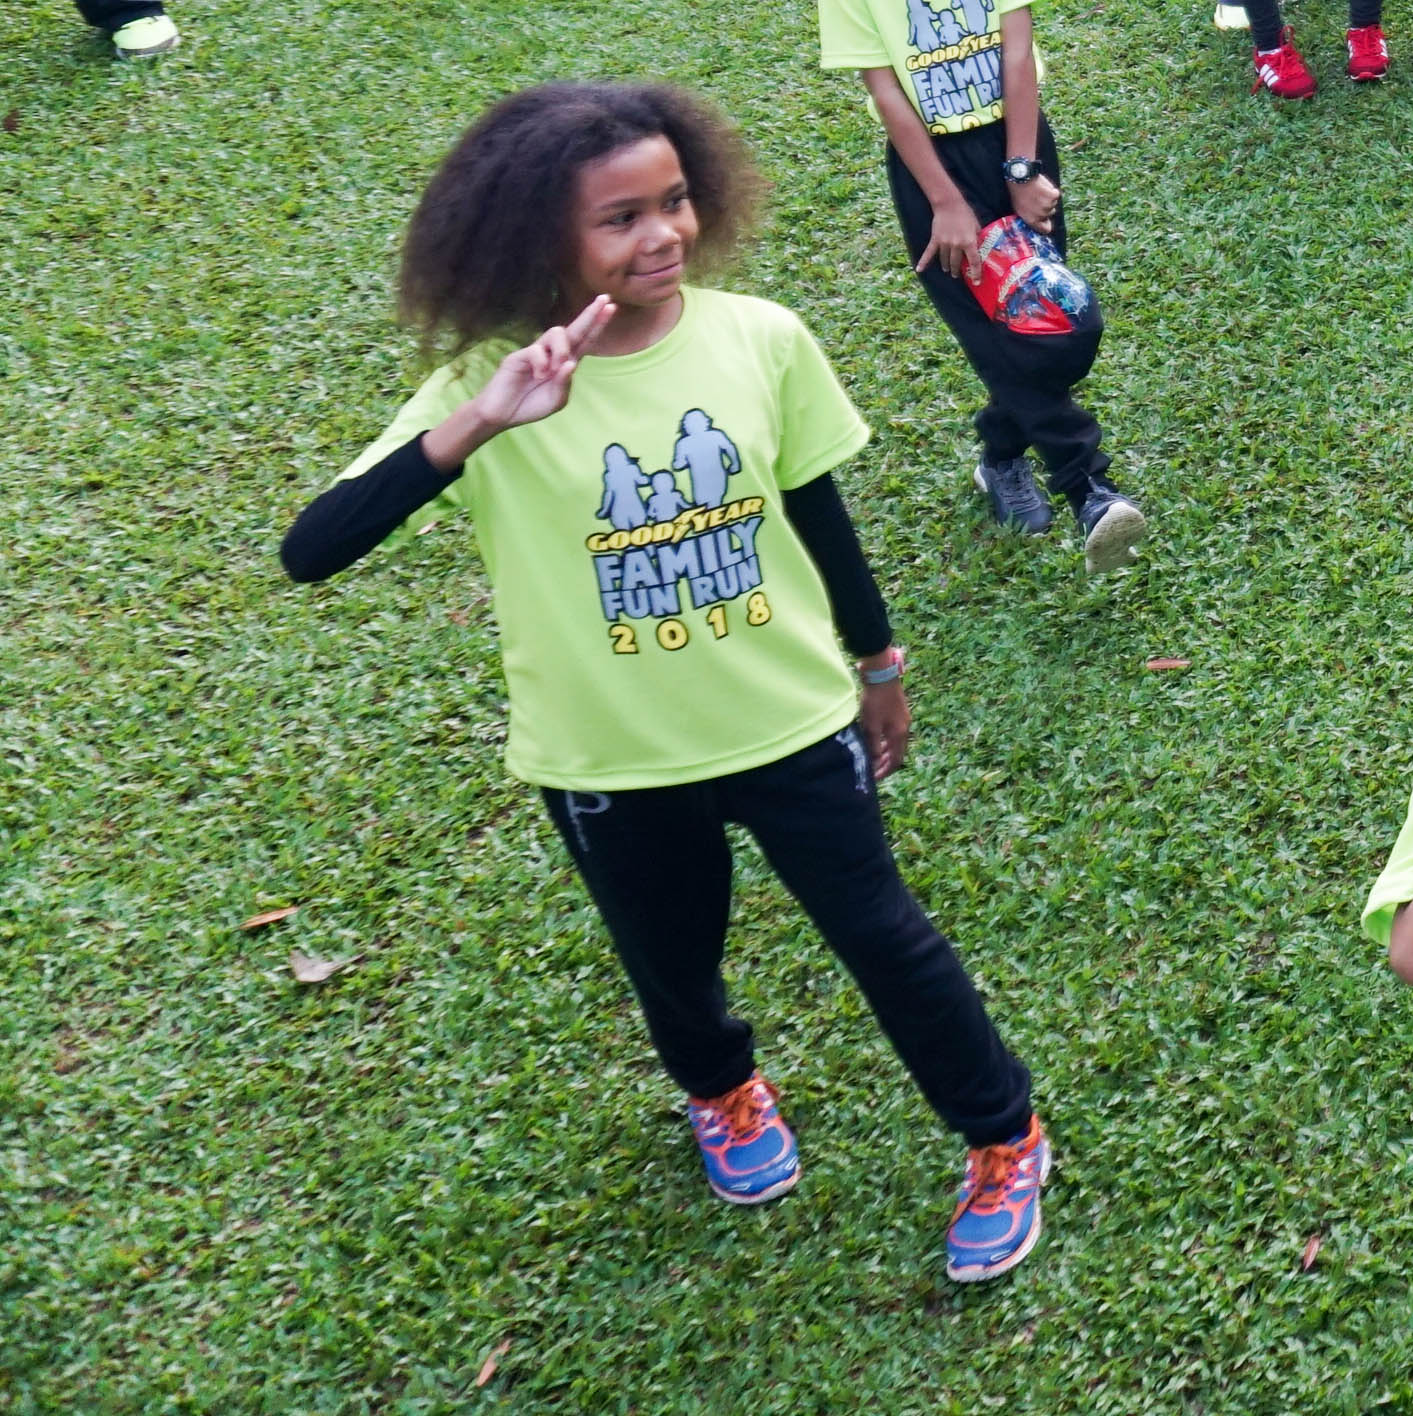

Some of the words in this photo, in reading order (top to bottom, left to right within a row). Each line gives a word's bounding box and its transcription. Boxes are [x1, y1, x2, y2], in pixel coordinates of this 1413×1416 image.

[906, 31, 1002, 71] GOODYEA
[919, 89, 975, 125] FUN
[977, 77, 1002, 108] RU
[586, 496, 766, 552] GOODYEAR
[593, 516, 764, 592] FAMILY
[599, 580, 682, 621] FUN
[690, 554, 763, 609] RUN
[609, 591, 771, 654] 2018
